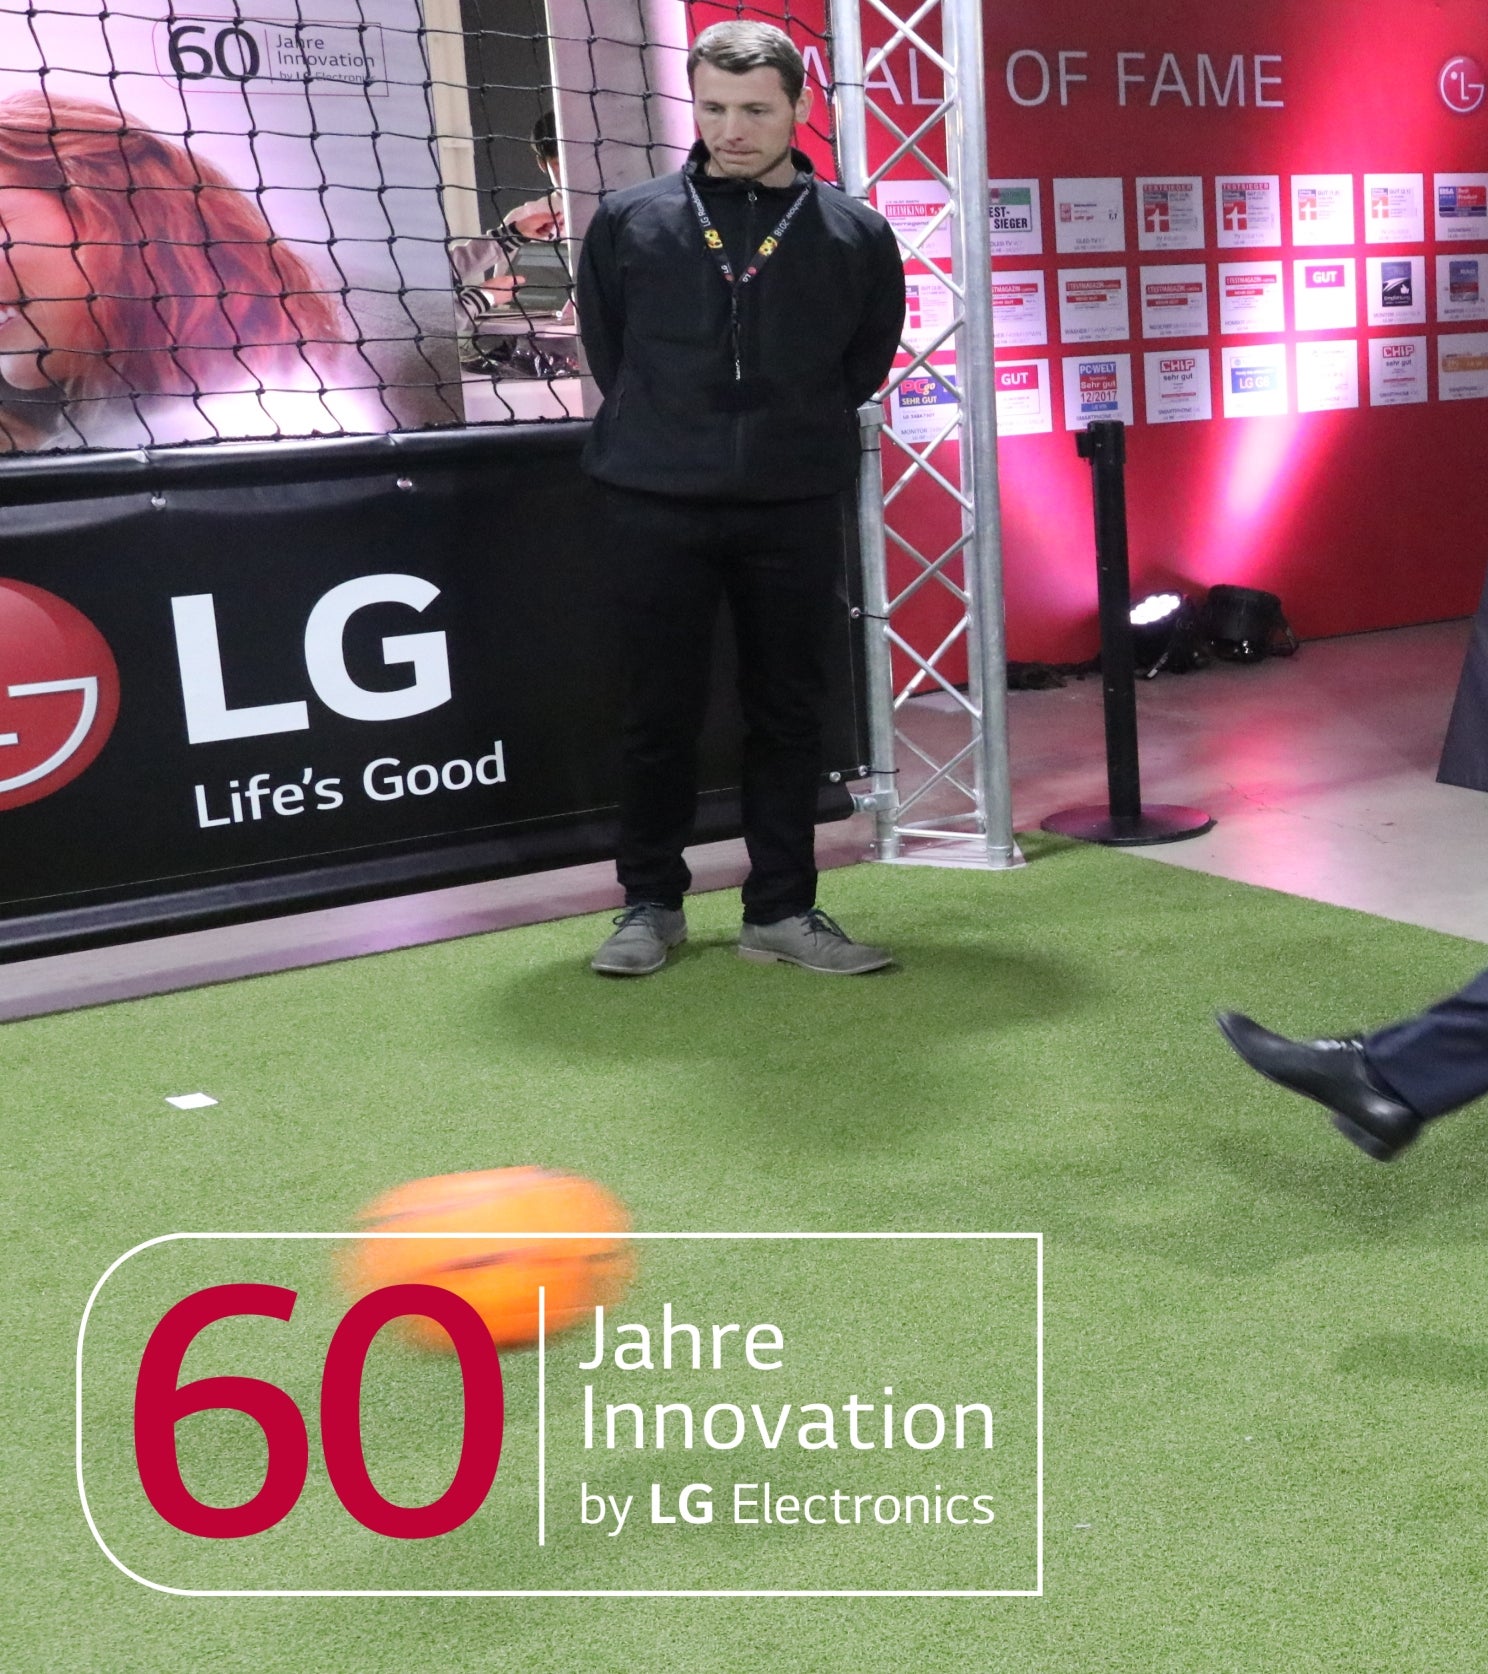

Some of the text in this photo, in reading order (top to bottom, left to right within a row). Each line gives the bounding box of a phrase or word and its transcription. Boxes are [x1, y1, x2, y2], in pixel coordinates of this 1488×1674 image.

[276, 34, 324, 49] Jahre
[168, 25, 260, 82] 60
[277, 51, 375, 68] Innovation
[1006, 49, 1088, 107] OF
[1117, 52, 1285, 108] FAME
[994, 217, 1028, 230] SIEGER
[1312, 271, 1337, 283] GUT
[1382, 345, 1414, 358] CHIP
[1160, 359, 1195, 372] CHIP
[1001, 372, 1029, 386] GUT
[1180, 373, 1192, 381] gut
[900, 379, 928, 395] PC
[1081, 380, 1116, 390] Sehr gut
[902, 396, 937, 406] SEHR GUT
[1081, 391, 1117, 402] 12/2017
[171, 573, 452, 745] LG
[195, 740, 506, 828] Life's Good
